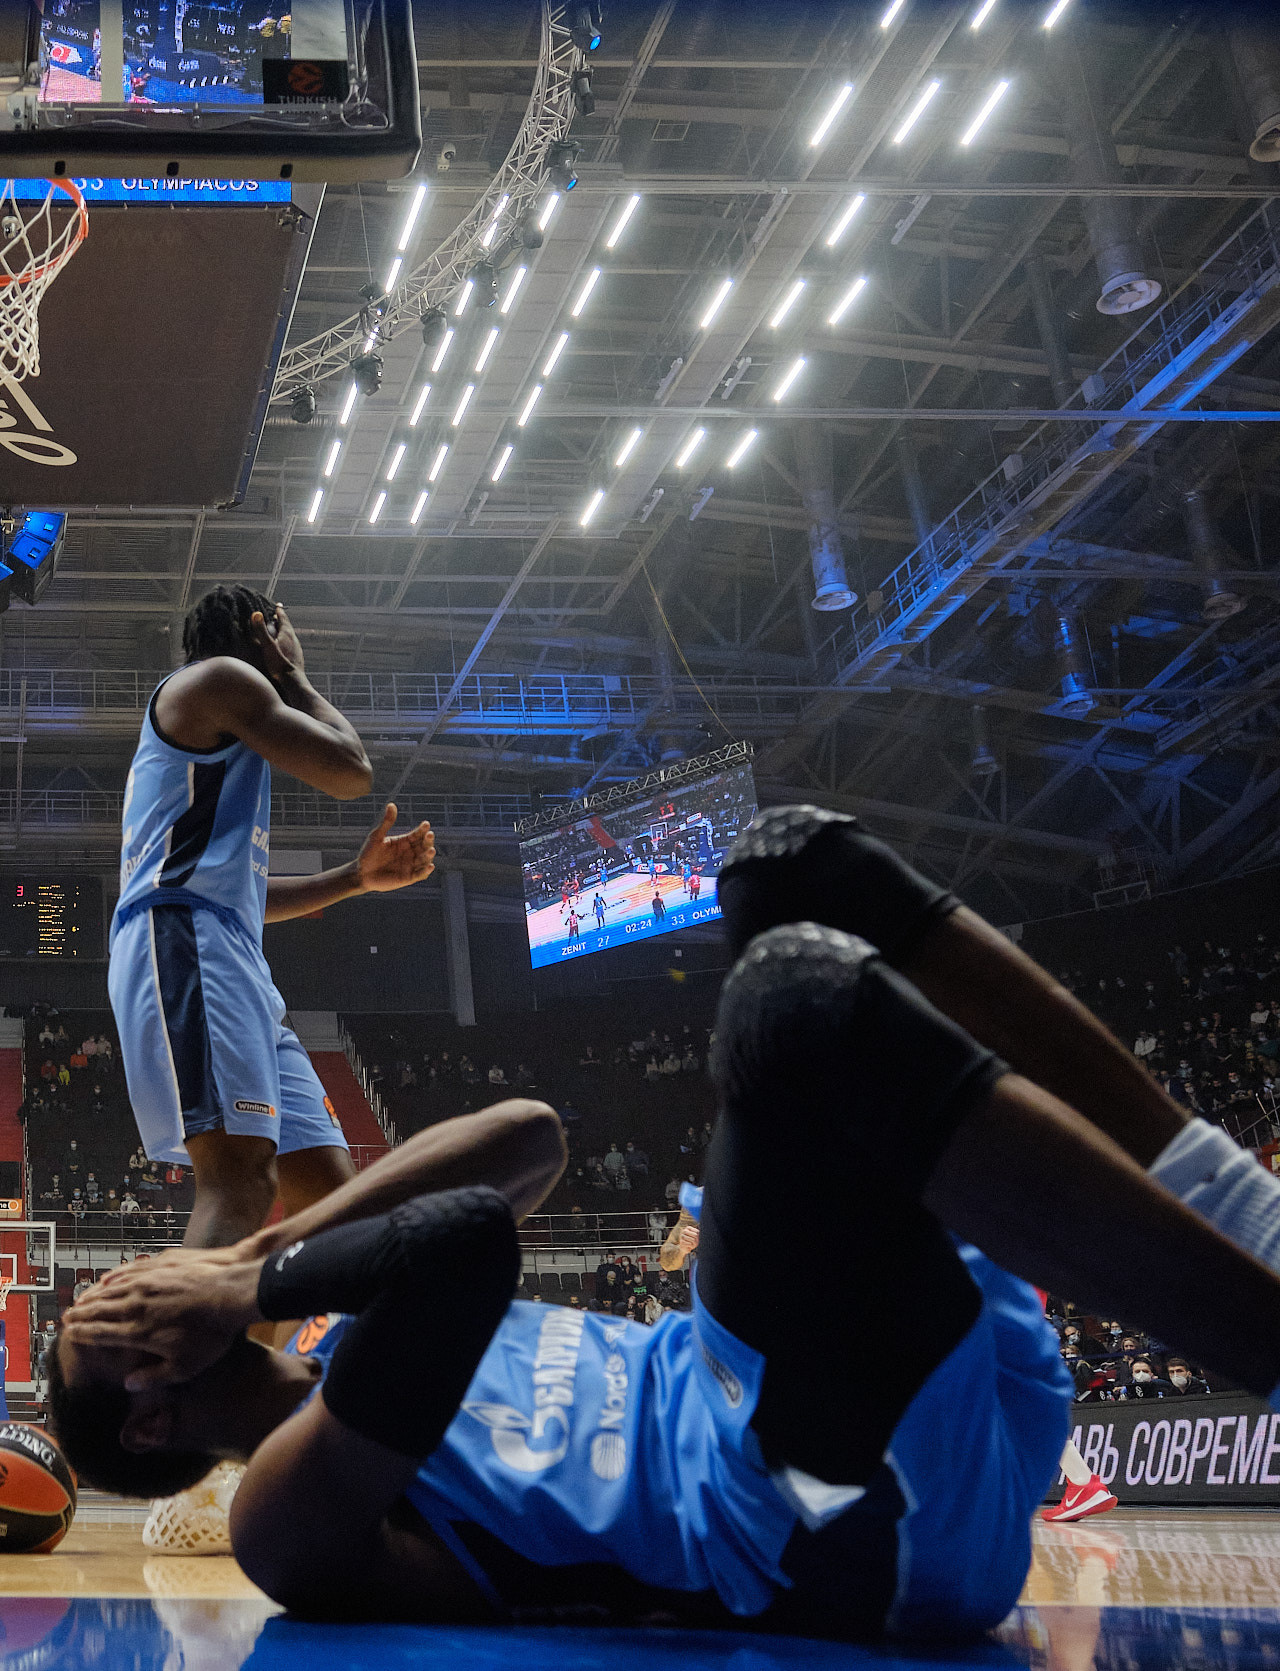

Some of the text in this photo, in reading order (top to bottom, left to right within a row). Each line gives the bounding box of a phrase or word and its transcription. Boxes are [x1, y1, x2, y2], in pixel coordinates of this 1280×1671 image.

[561, 941, 587, 956] ZENIT
[597, 936, 610, 948] 27
[625, 918, 653, 934] 02:24
[671, 914, 686, 926] 33
